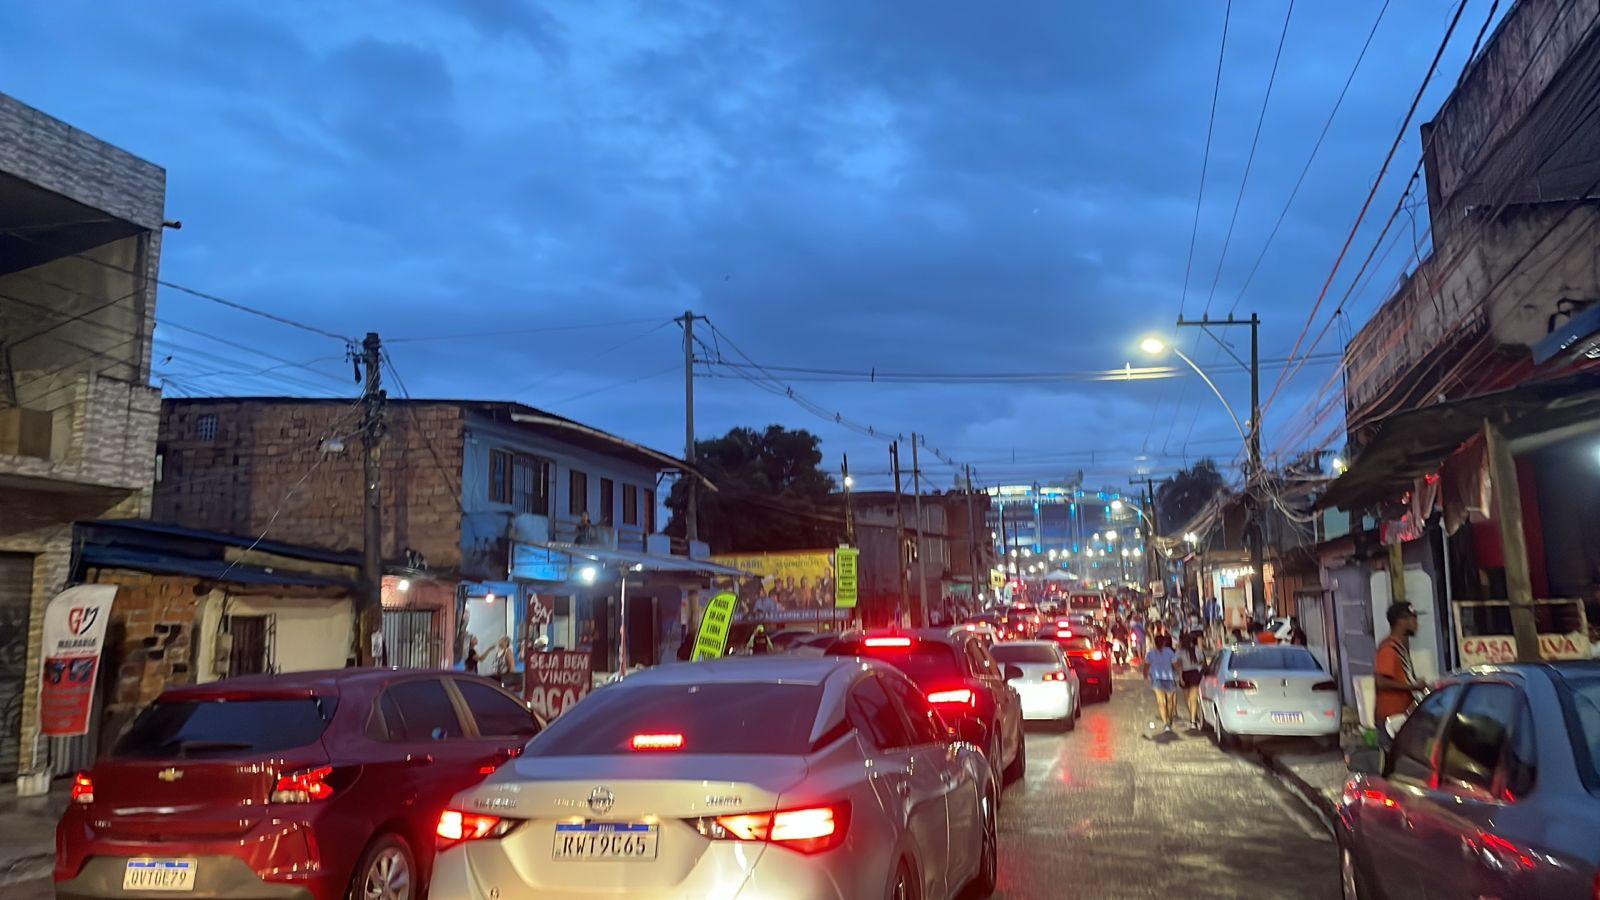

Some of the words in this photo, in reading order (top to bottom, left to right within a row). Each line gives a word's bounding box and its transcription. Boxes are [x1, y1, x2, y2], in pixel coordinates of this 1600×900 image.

[1463, 640, 1515, 657] CASA
[530, 653, 560, 670] SEJA
[538, 670, 581, 685] VINDO
